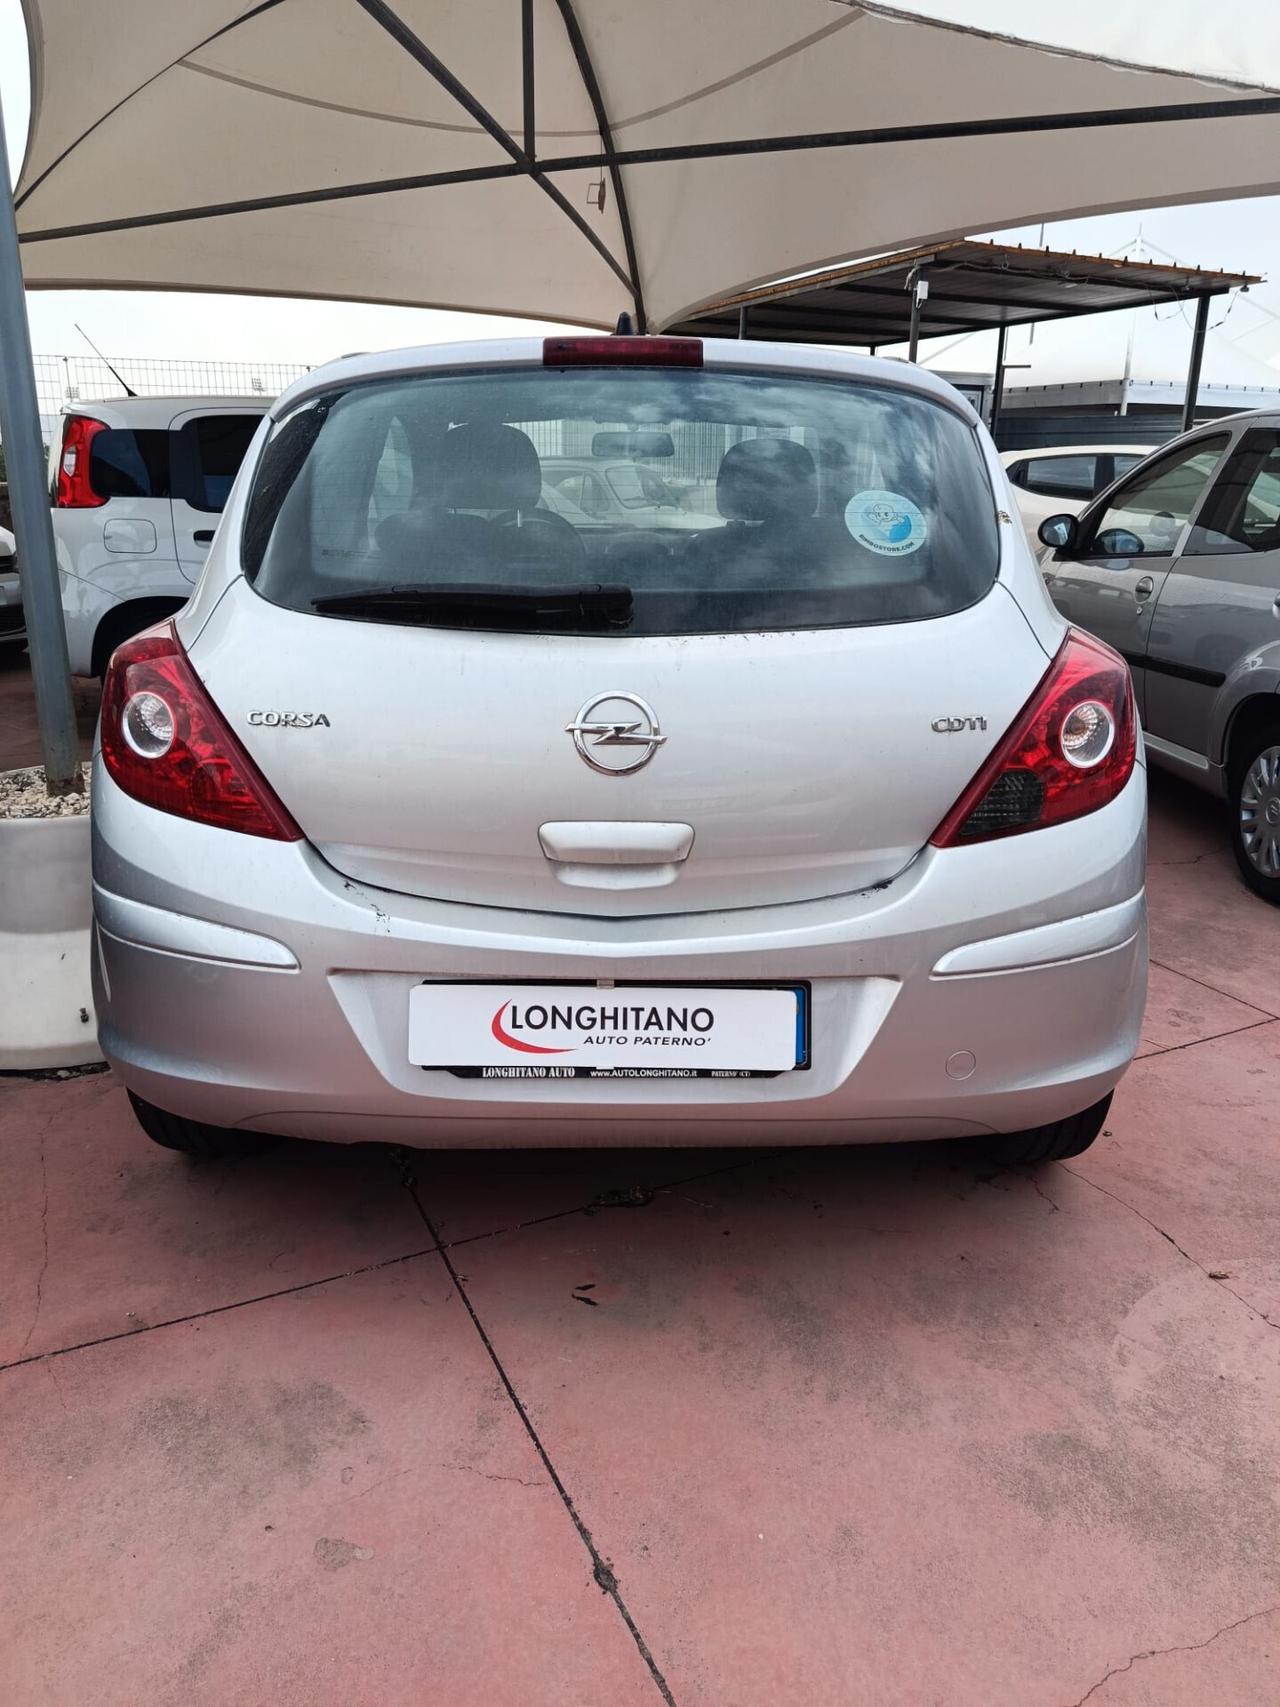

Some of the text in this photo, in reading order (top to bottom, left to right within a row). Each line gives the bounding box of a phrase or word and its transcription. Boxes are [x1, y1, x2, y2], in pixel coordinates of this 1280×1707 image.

[247, 711, 331, 728] CORSA
[511, 1005, 715, 1033] LONGHITANO
[583, 1035, 628, 1046] AUTO
[482, 1067, 576, 1078] LONGHITANO AUTO
[590, 1069, 698, 1078] www.AUTOLONGHITANO.it
